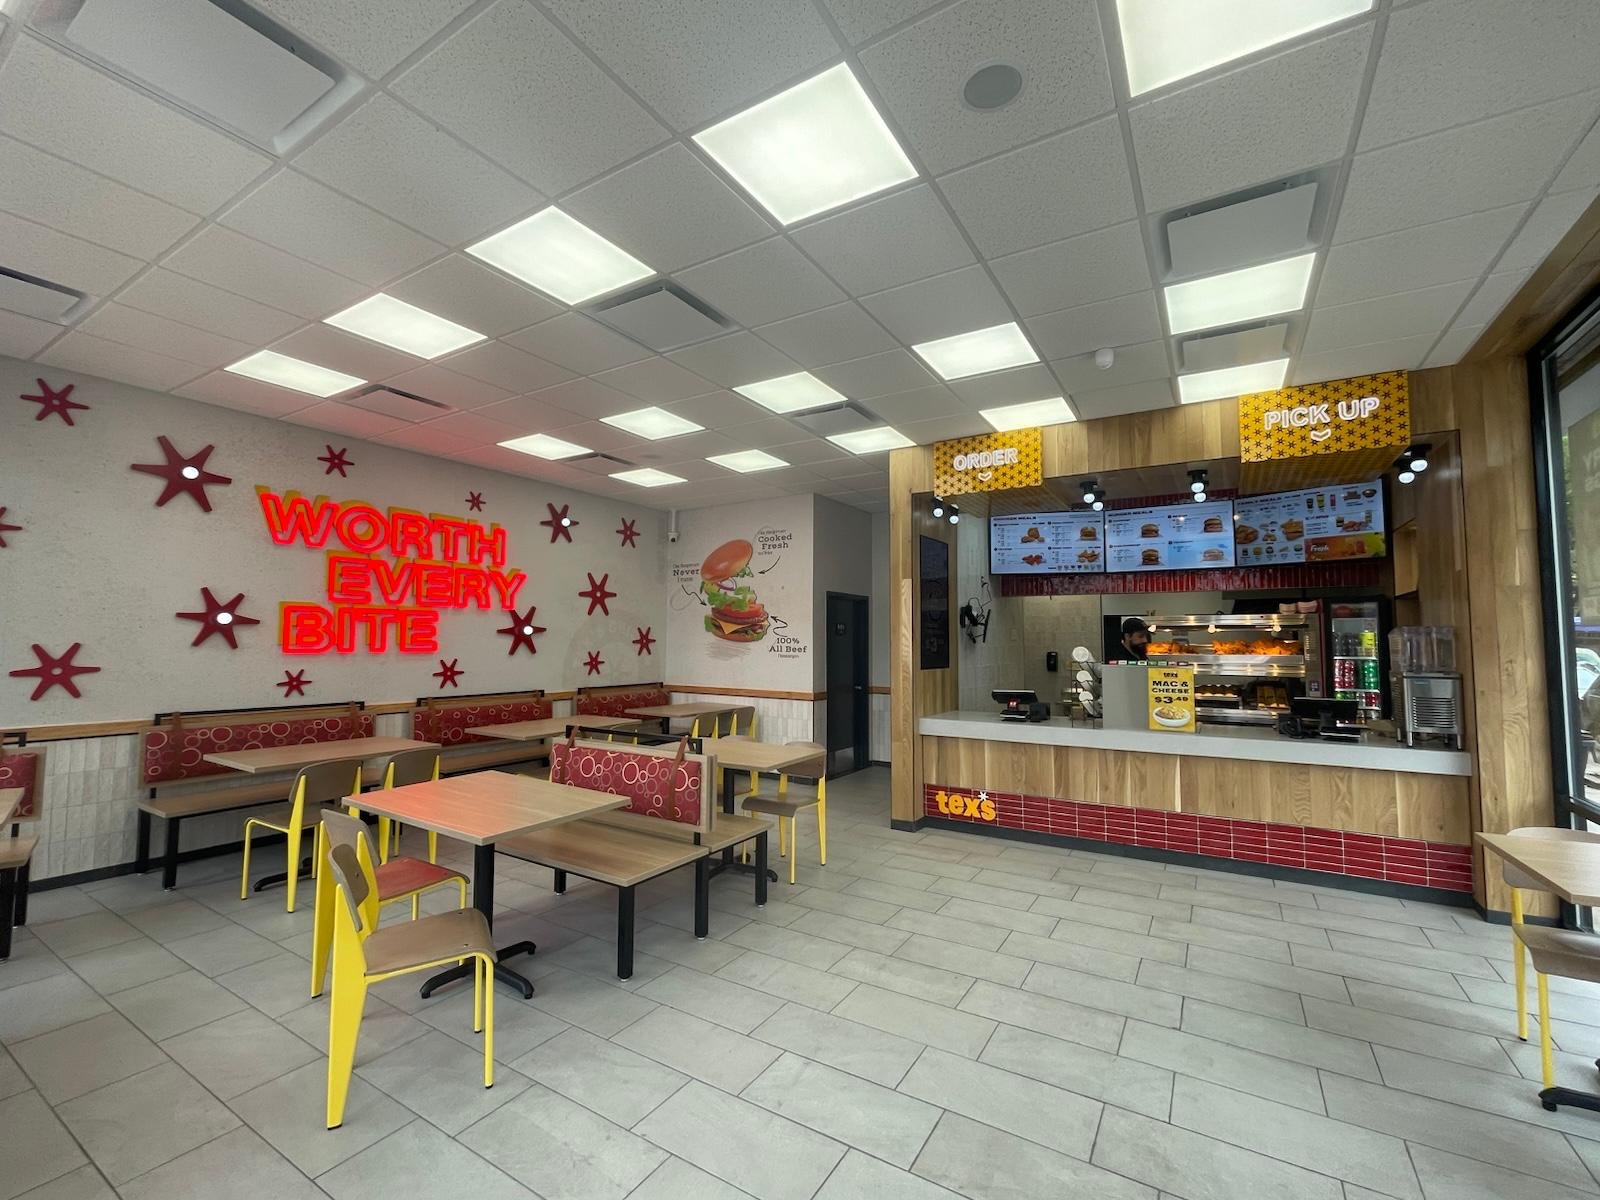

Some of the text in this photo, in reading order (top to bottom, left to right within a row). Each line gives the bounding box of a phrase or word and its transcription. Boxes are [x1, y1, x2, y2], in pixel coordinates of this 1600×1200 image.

[1264, 397, 1380, 430] PICK UP
[953, 448, 1019, 471] ORDER
[255, 485, 507, 567] WORTH
[758, 533, 792, 542] Cooked
[762, 541, 788, 550] Fresh
[327, 550, 527, 610] EVERY
[279, 602, 440, 655] BITE
[769, 645, 807, 653] All Beef
